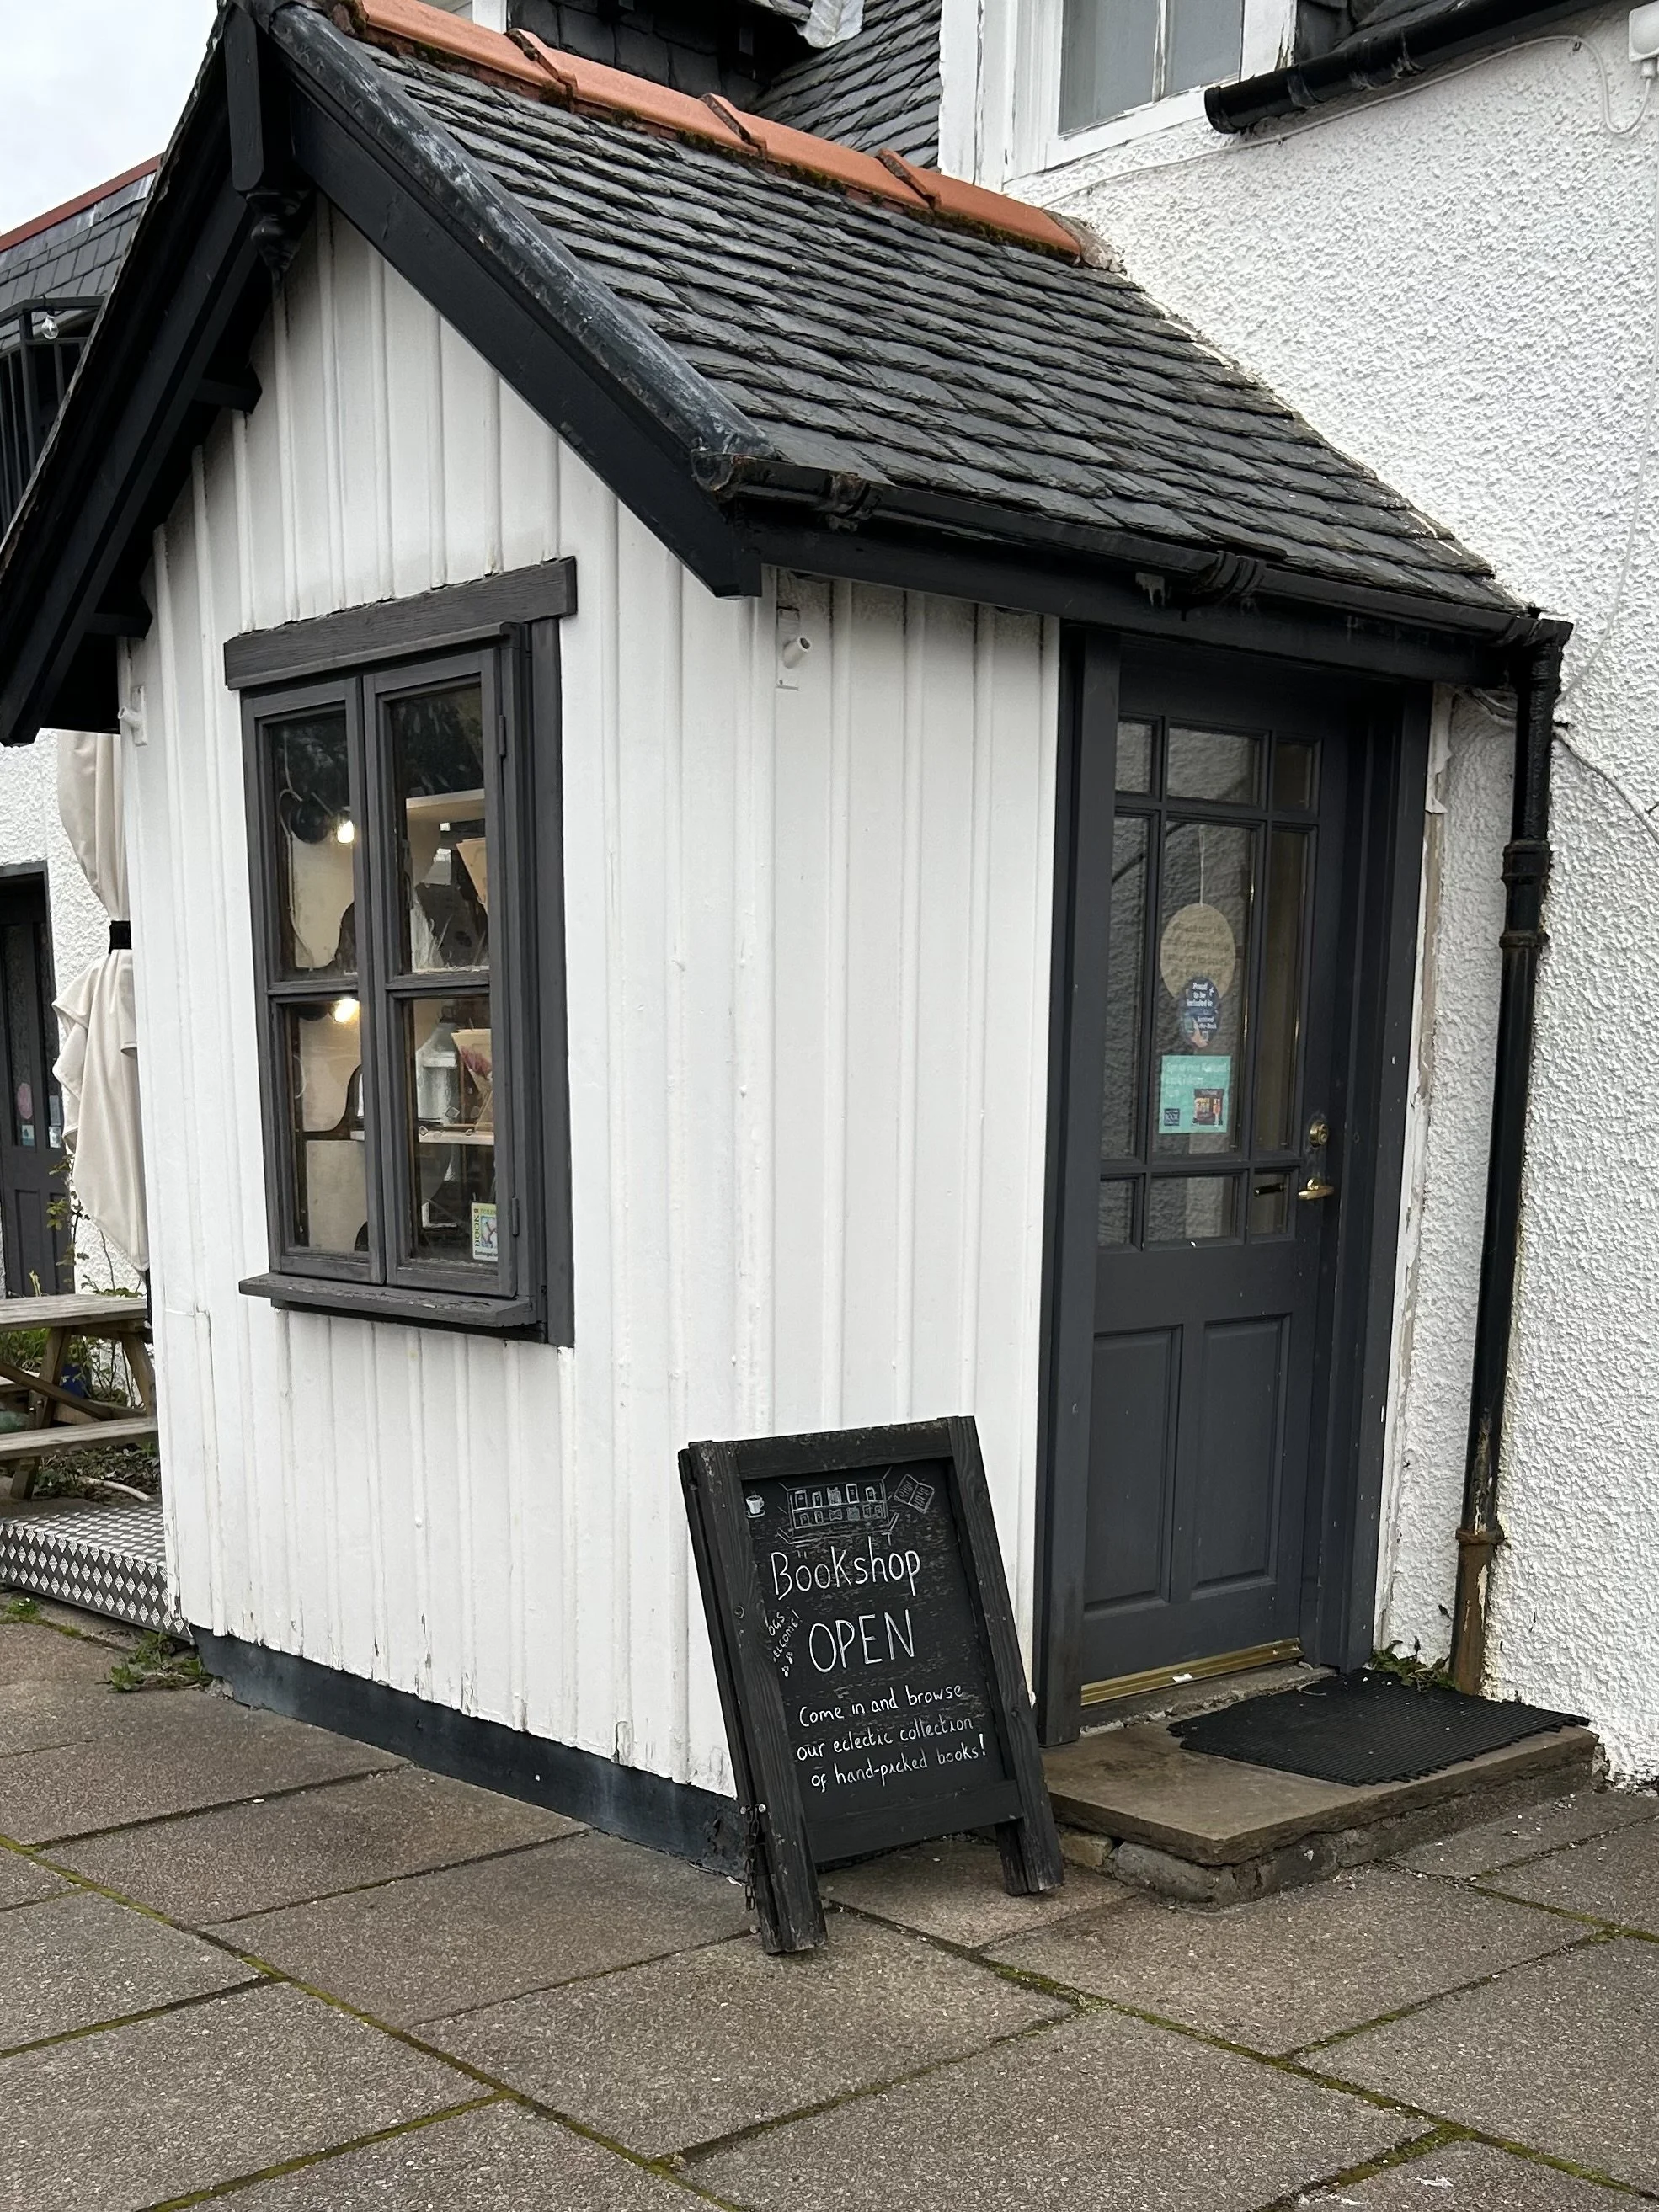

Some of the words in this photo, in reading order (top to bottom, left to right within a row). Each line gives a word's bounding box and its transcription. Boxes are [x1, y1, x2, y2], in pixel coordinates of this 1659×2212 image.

[771, 1535, 920, 1600] Bookshop
[765, 1611, 785, 1636] OGS
[773, 1608, 803, 1663] ELCOME!
[808, 1609, 915, 1673] OPEN
[799, 1706, 842, 1727] Come
[851, 1703, 866, 1715] in
[871, 1687, 899, 1714] and
[905, 1684, 963, 1707] browse
[797, 1743, 826, 1761] our
[833, 1728, 894, 1753] eclectic
[899, 1715, 974, 1742] collection
[811, 1771, 827, 1793] of
[835, 1751, 928, 1786] hand-picked
[936, 1733, 987, 1765] books!
